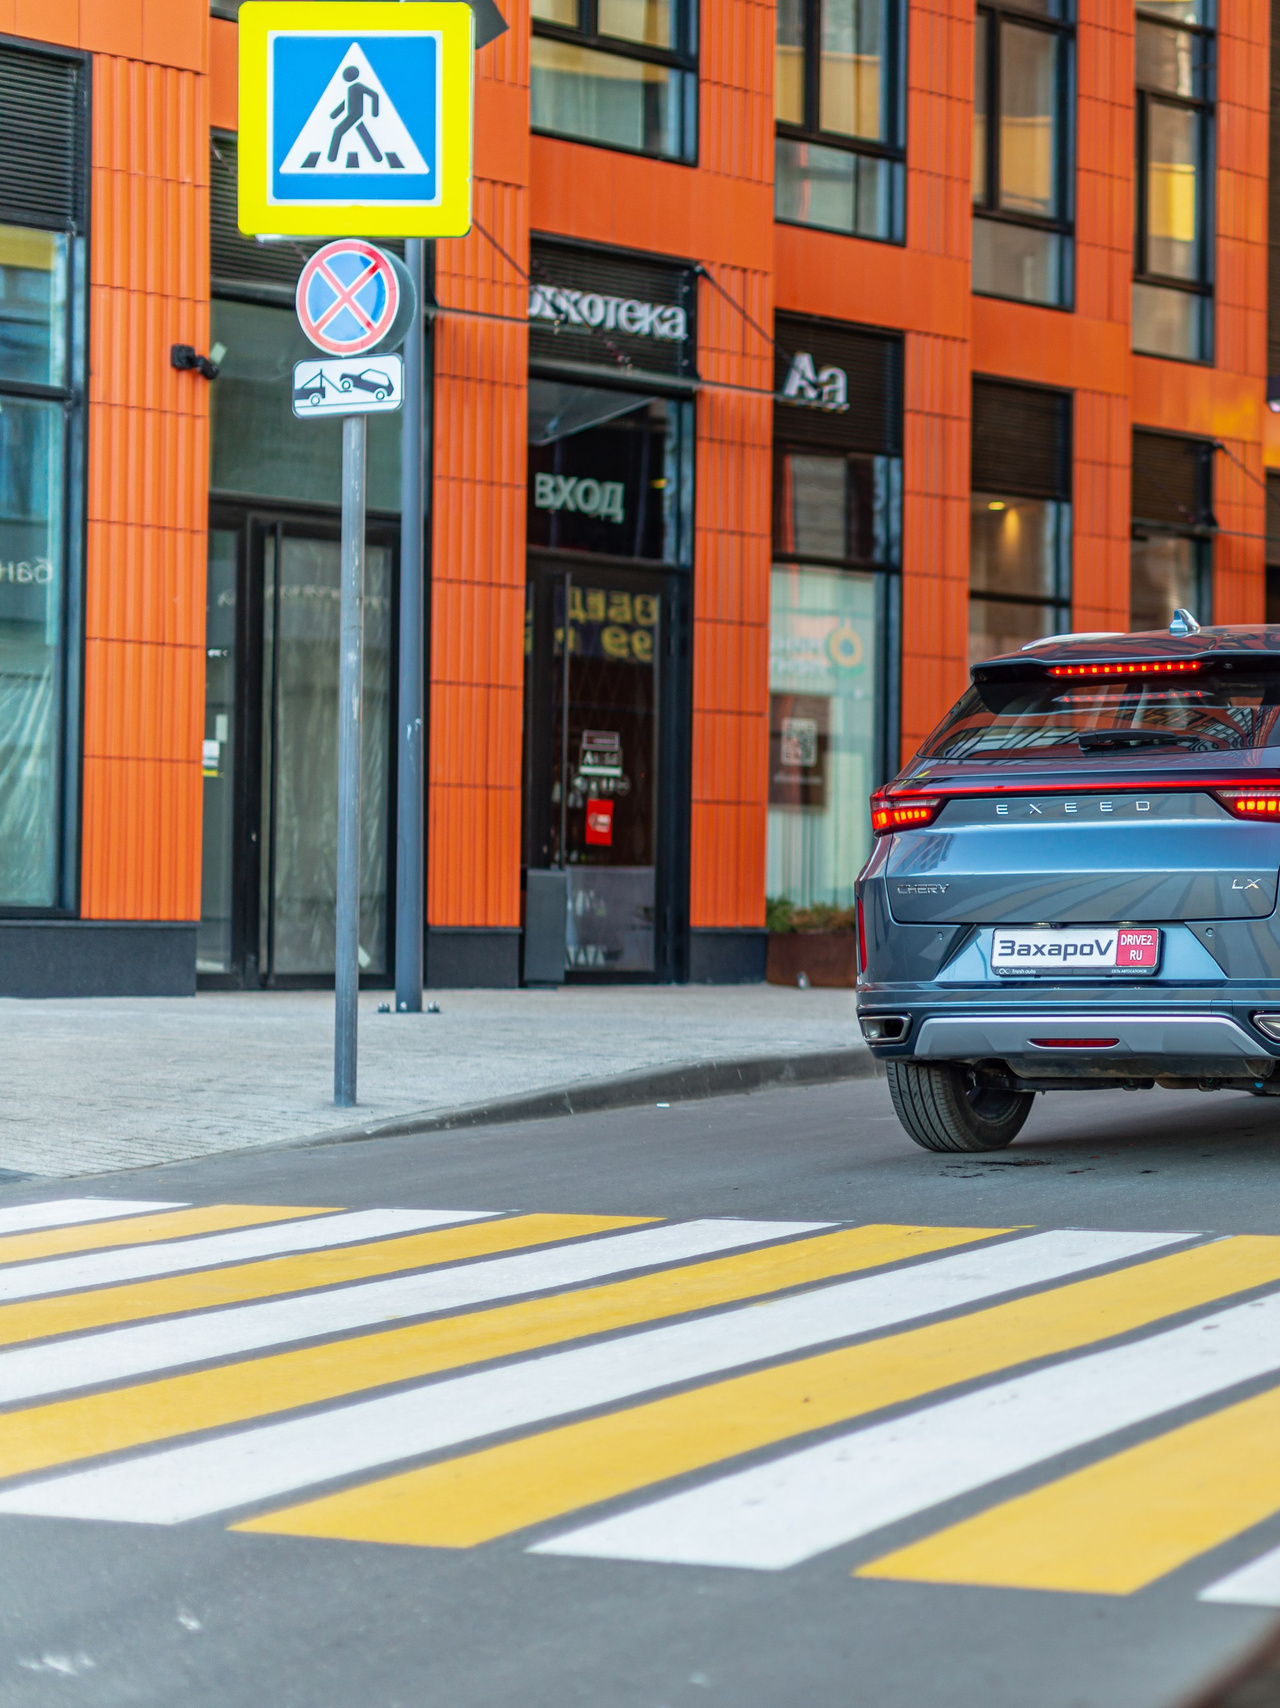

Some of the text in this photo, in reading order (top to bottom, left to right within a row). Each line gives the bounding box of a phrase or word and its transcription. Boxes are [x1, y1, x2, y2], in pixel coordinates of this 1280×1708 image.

[535, 473, 625, 524] ВХОД
[996, 800, 1150, 815] EXEED
[897, 883, 949, 894] CHERY
[1231, 878, 1262, 890] LX
[1129, 950, 1143, 961] RU
